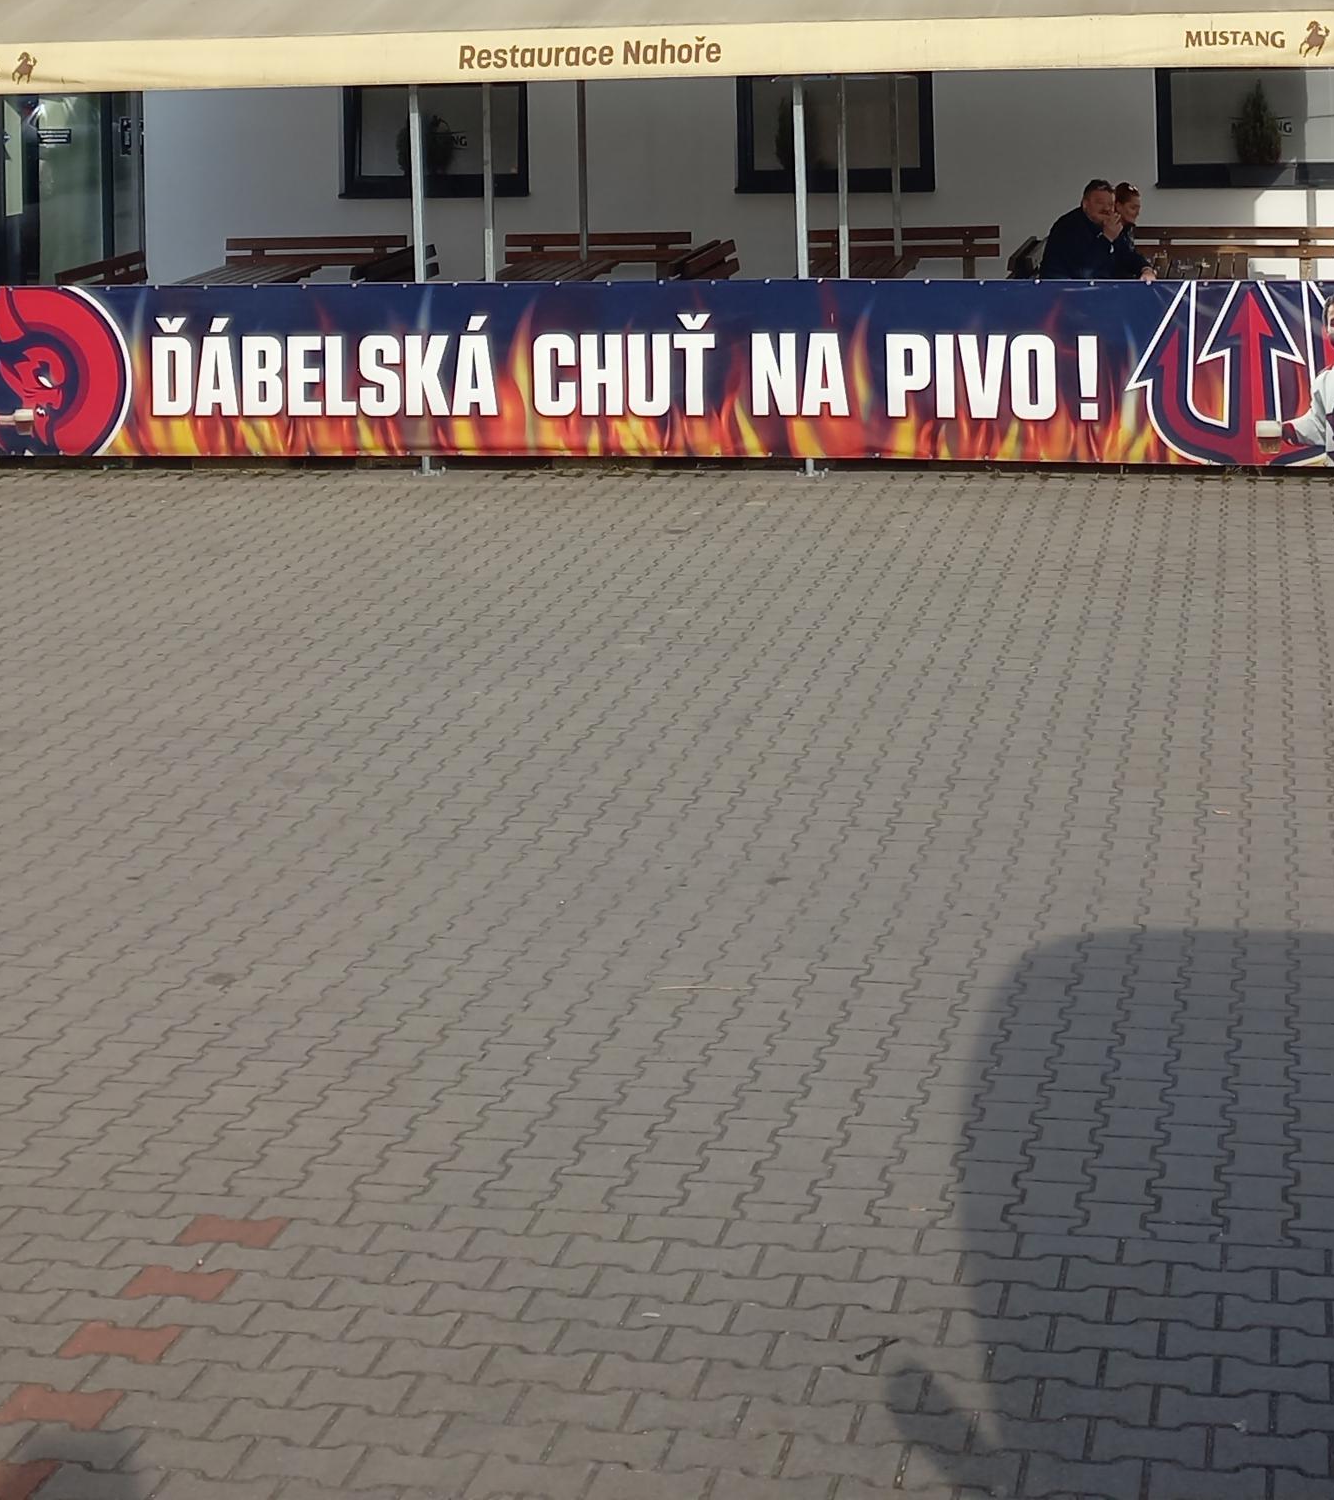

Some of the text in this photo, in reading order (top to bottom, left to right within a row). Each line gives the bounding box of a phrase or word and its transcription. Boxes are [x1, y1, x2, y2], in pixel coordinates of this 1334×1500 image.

[458, 36, 722, 70] Restaurace Nahoře
[1184, 30, 1286, 49] MUSTANG
[151, 313, 1099, 422] ĎÁBELSKÁ CHUŤ NA PIVO !
